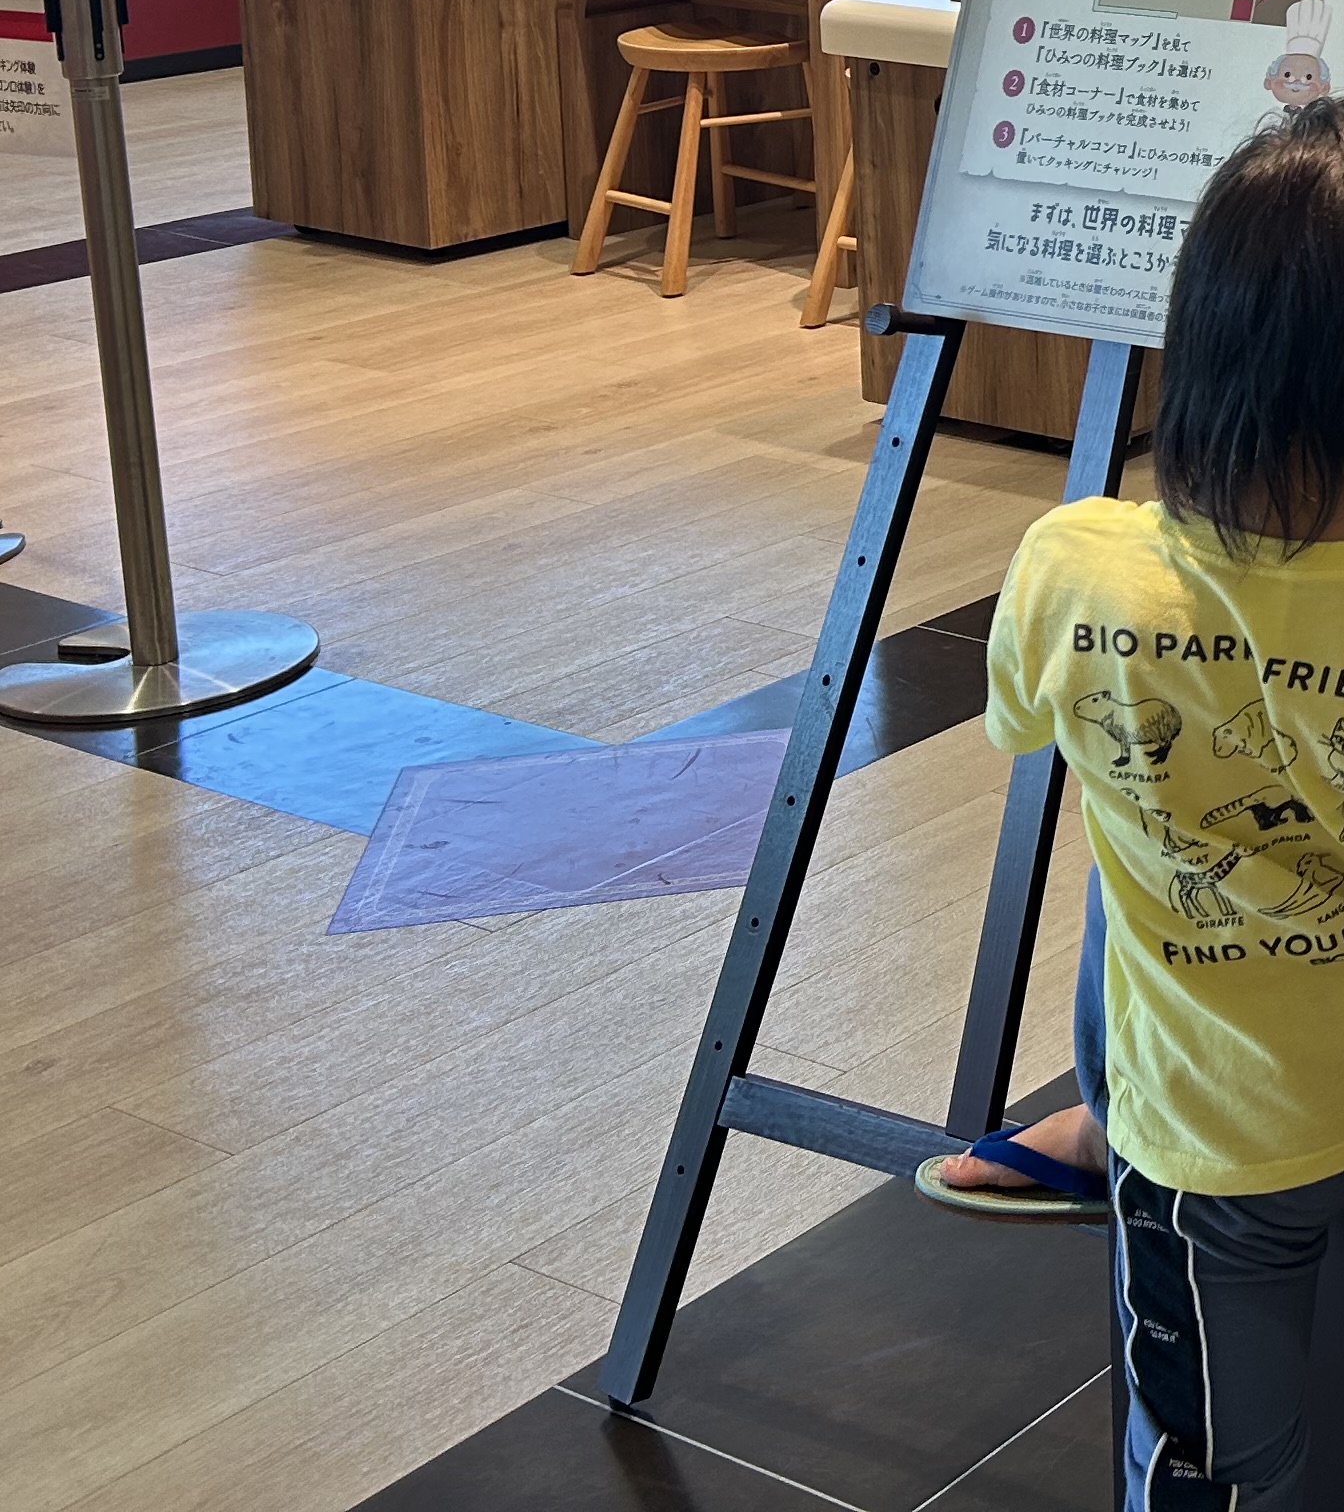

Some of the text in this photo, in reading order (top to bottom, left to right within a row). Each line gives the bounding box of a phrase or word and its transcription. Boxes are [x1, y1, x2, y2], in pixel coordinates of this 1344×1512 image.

[1073, 623, 1139, 657] BIO
[1108, 770, 1171, 783] CAPYBARA
[1196, 916, 1245, 929] GIRAFFE
[1162, 941, 1247, 966] FIND
